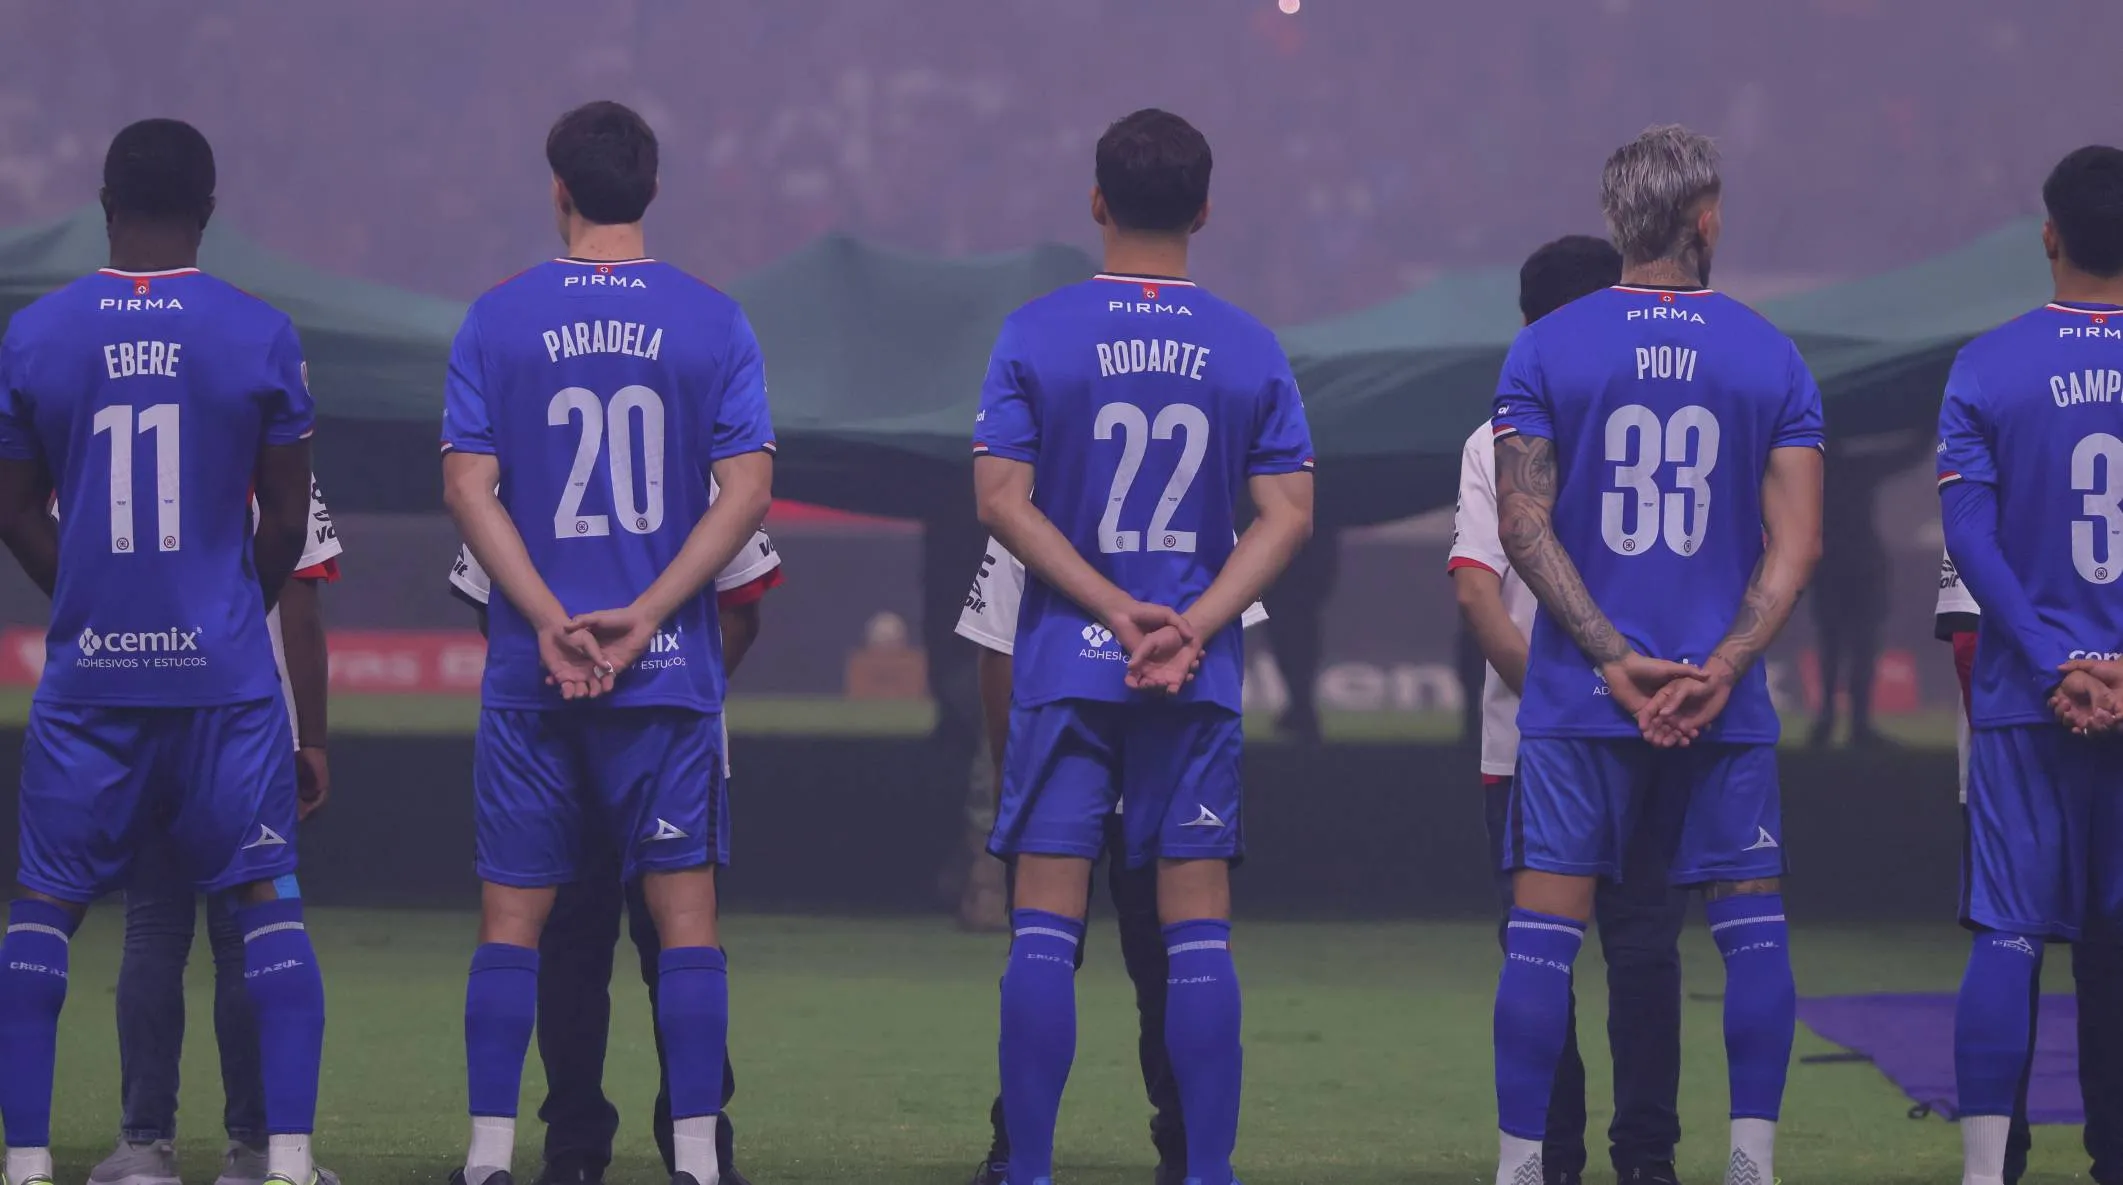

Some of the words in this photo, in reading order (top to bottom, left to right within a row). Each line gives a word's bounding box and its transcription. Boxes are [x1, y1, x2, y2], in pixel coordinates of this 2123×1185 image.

[564, 274, 647, 289] PIRMA
[100, 298, 183, 311] PIRMA
[1108, 300, 1193, 316] PIRMA
[1627, 306, 1706, 325] PIRMA
[542, 319, 663, 363] PARADELA
[103, 340, 182, 379] EBERE
[1095, 338, 1210, 381] RODARTE
[1635, 345, 1698, 382] PIOVI
[2049, 369, 2123, 408] CAMP
[547, 384, 665, 539] 20
[93, 403, 180, 554] 11
[1093, 401, 1210, 554] 22
[1601, 404, 1721, 557] 33
[104, 626, 198, 652] cemix
[76, 657, 139, 668] ADHESIVOS
[142, 658, 151, 668] Y
[154, 656, 207, 668] ESTUCOS
[641, 656, 686, 670] ESTUCOS
[10, 961, 47, 973] CRUZ
[262, 959, 304, 975] AZUL
[1510, 952, 1544, 965] CRUZ
